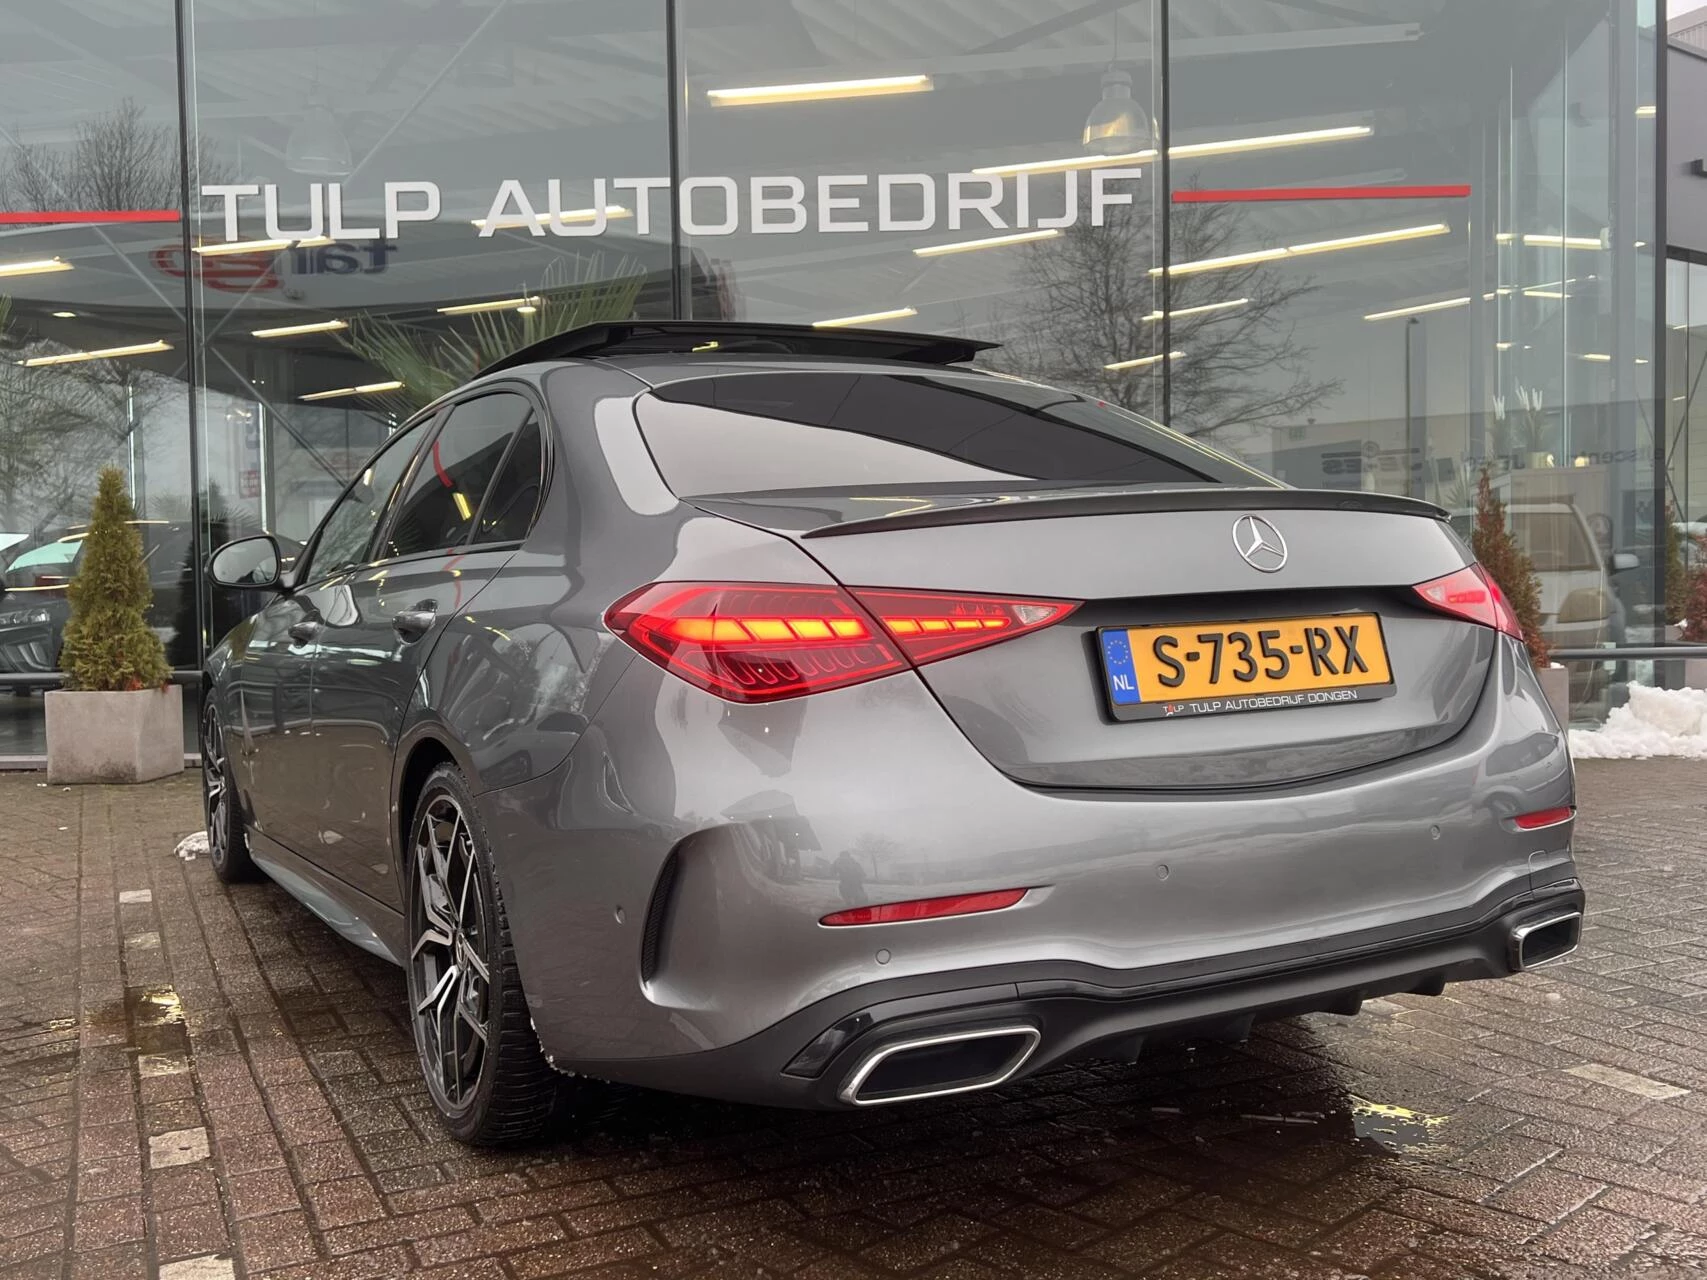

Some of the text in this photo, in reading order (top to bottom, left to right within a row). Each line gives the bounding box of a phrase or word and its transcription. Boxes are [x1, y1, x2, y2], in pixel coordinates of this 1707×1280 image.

[201, 169, 1142, 242] TULP AUTOBEDRIJF
[1152, 624, 1369, 688] S-735-RX
[1112, 674, 1135, 691] NL
[1189, 702, 1221, 714] TULP
[1225, 694, 1304, 711] AUTOBEDRIJF
[1307, 689, 1358, 704] DONGEN
